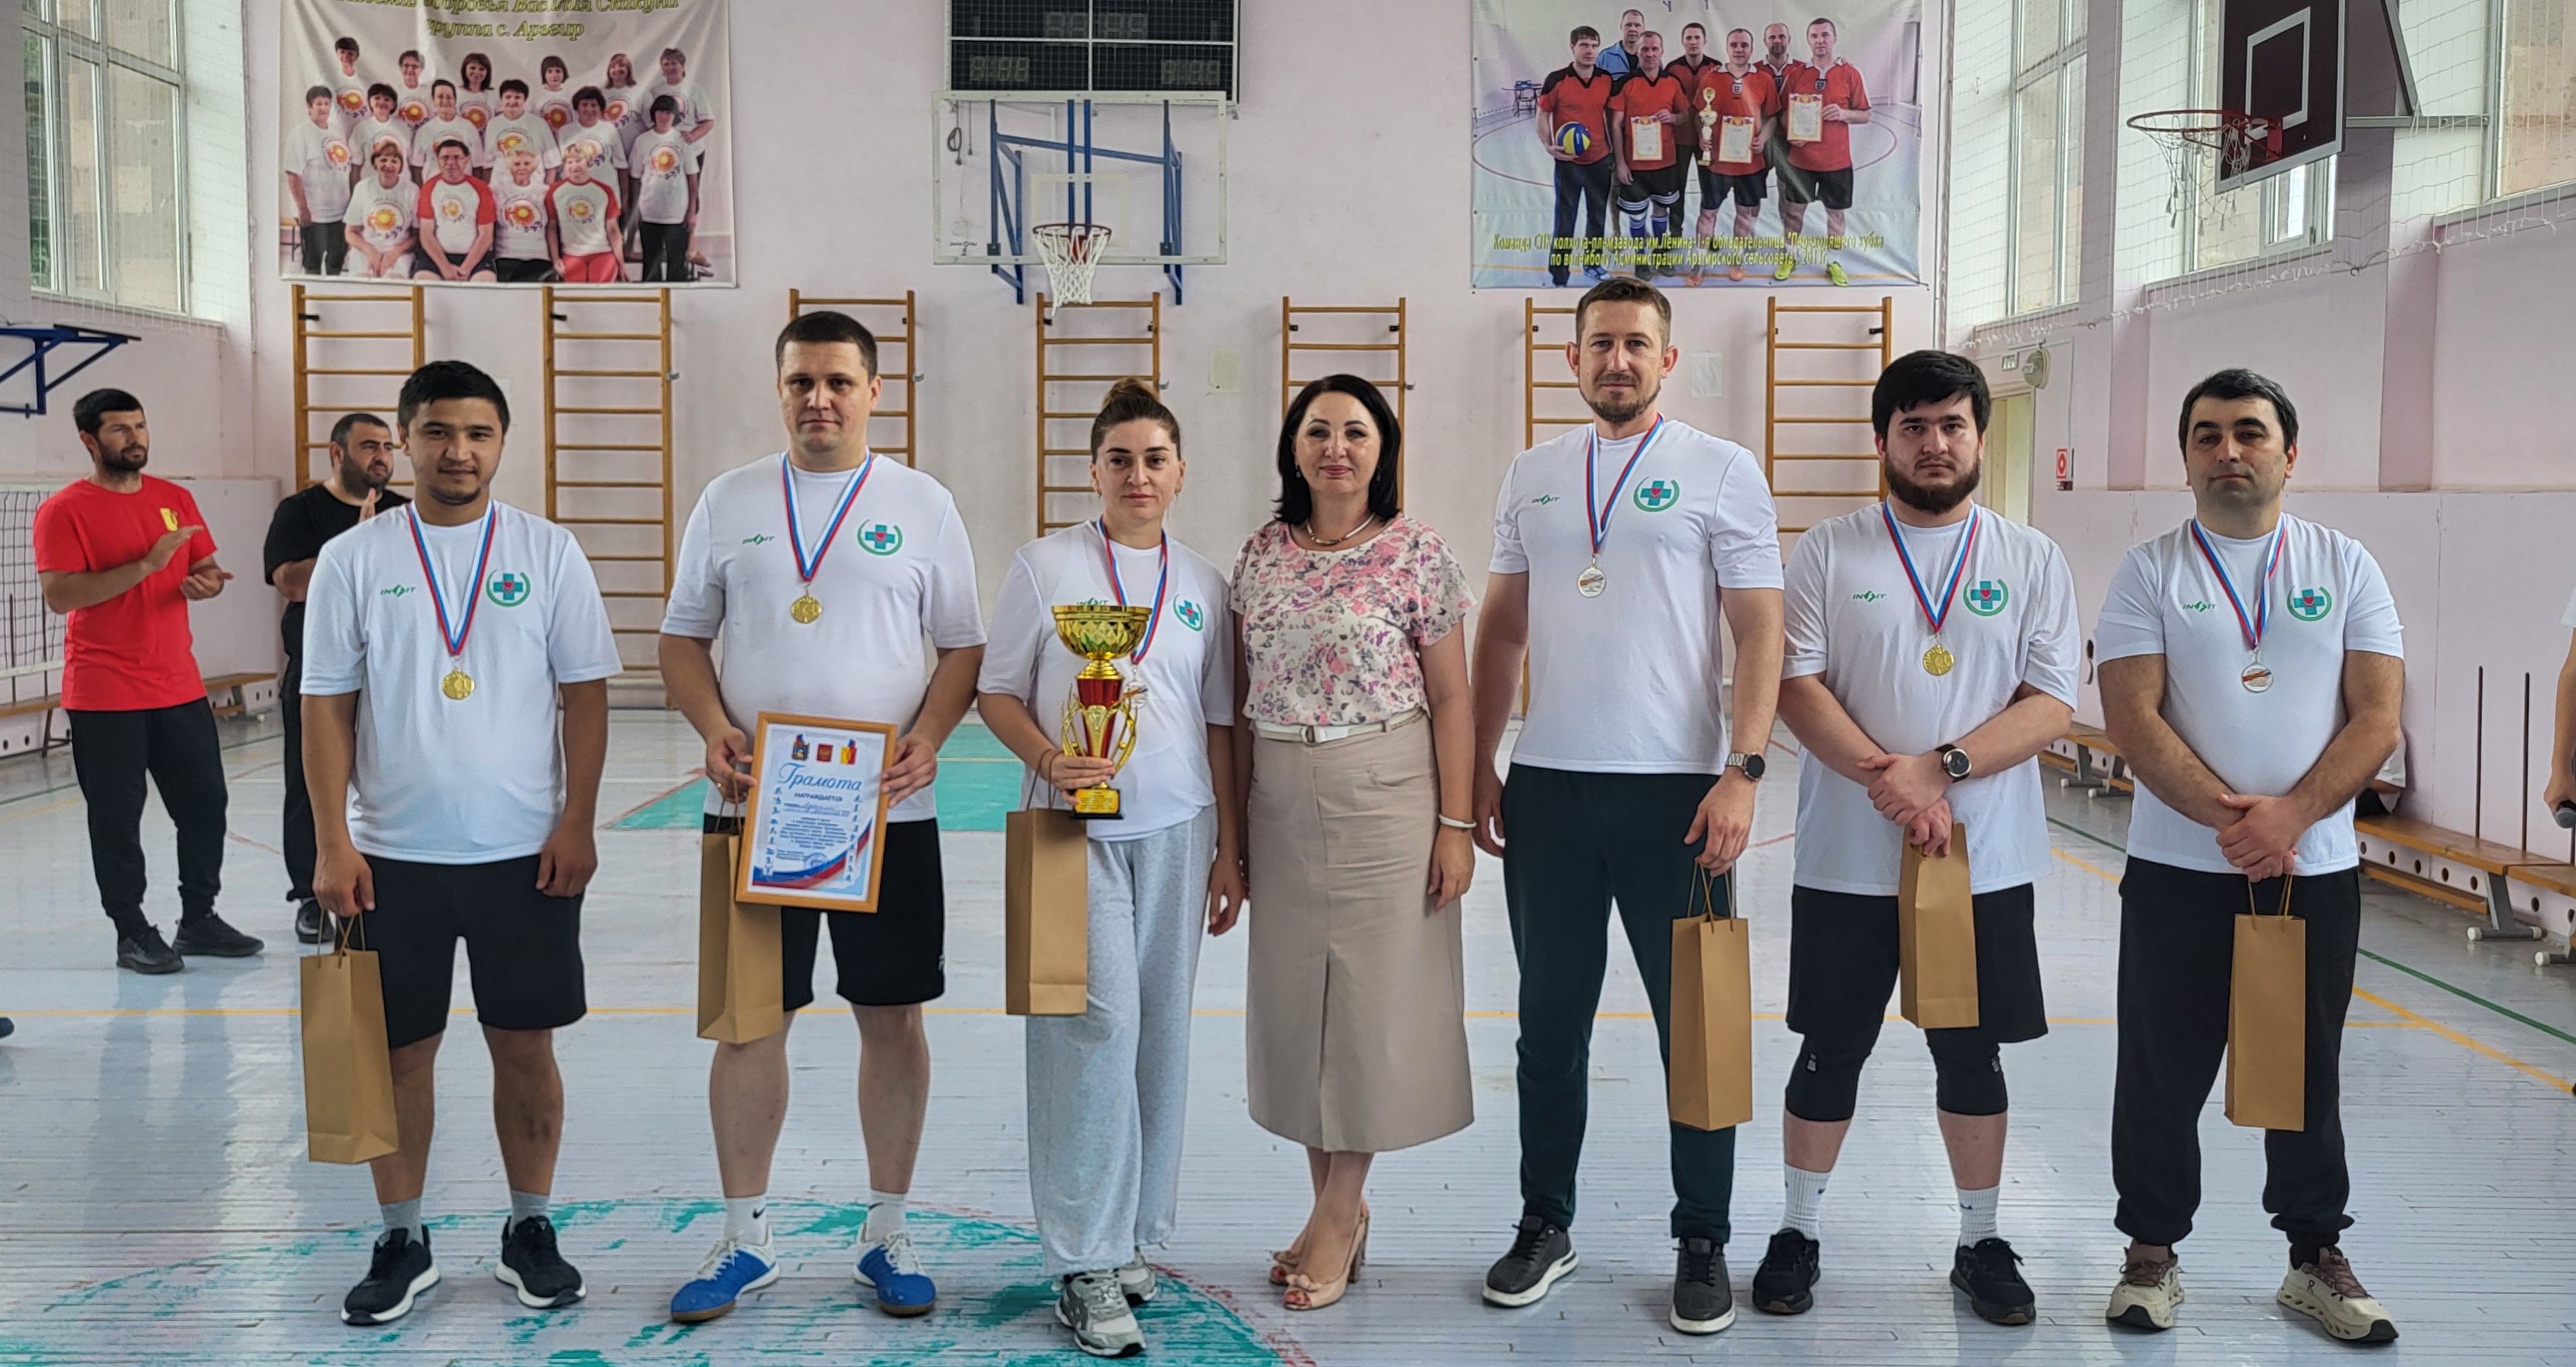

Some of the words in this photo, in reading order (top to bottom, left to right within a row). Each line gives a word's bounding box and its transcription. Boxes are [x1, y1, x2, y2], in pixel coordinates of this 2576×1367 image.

[513, 20, 585, 41] Арзгир
[1493, 233, 1532, 253] Команда
[1712, 232, 1785, 252] обладательница
[1858, 230, 1884, 252] кубка
[1550, 253, 1562, 266] по
[1563, 249, 1611, 269] волейболу
[1613, 249, 1684, 269] Администрации
[1686, 249, 1742, 269] Арзгирского
[777, 762, 863, 791] Грамота
